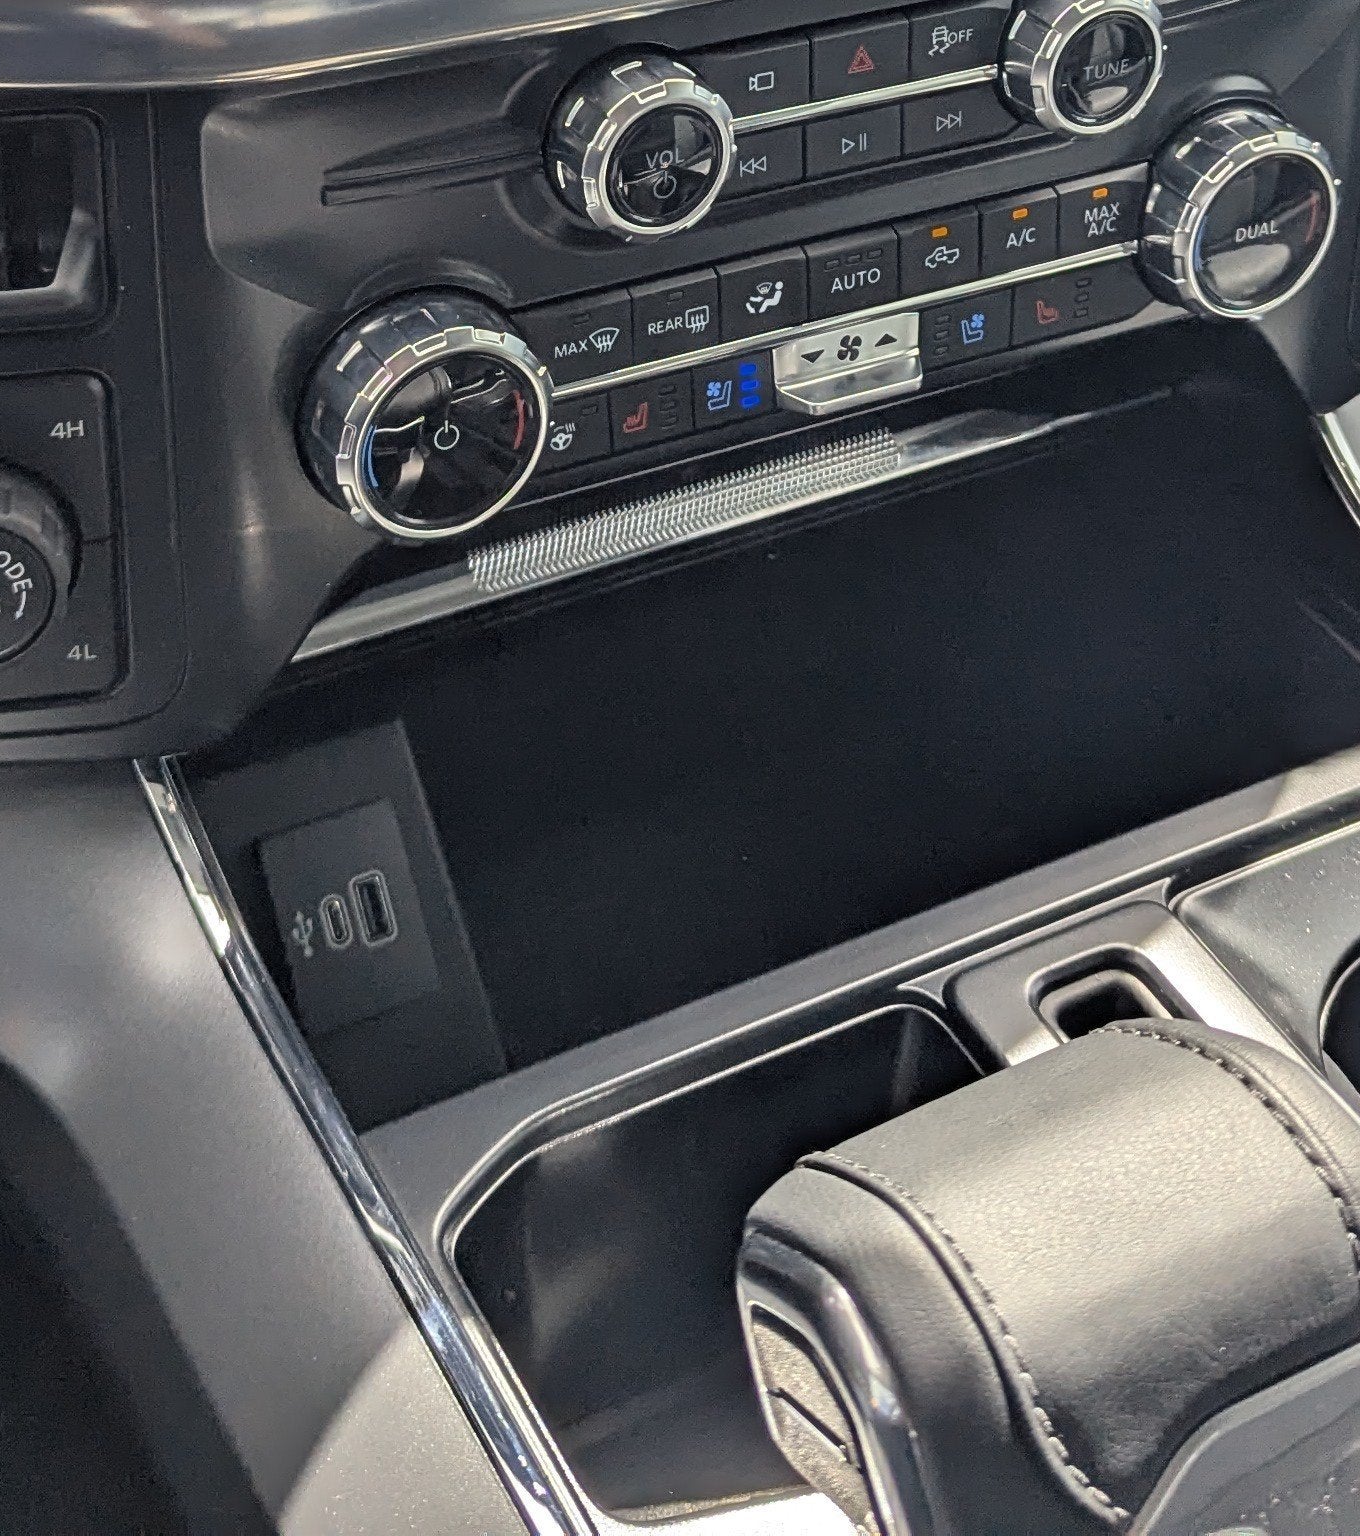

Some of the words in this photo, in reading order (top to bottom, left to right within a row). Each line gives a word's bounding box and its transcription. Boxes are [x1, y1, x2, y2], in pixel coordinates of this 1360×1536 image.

[948, 27, 974, 45] OFF
[1083, 58, 1131, 82] TUNE
[646, 149, 685, 169] VOL
[1083, 202, 1121, 225] MAX
[1005, 226, 1037, 249] A/C
[1086, 217, 1118, 239] A/C
[1234, 219, 1279, 243] DUAL
[830, 267, 882, 293] AUTO
[648, 314, 684, 336] REAR
[553, 337, 590, 359] MAX
[49, 419, 85, 440] 4H
[66, 644, 98, 662] 4L
